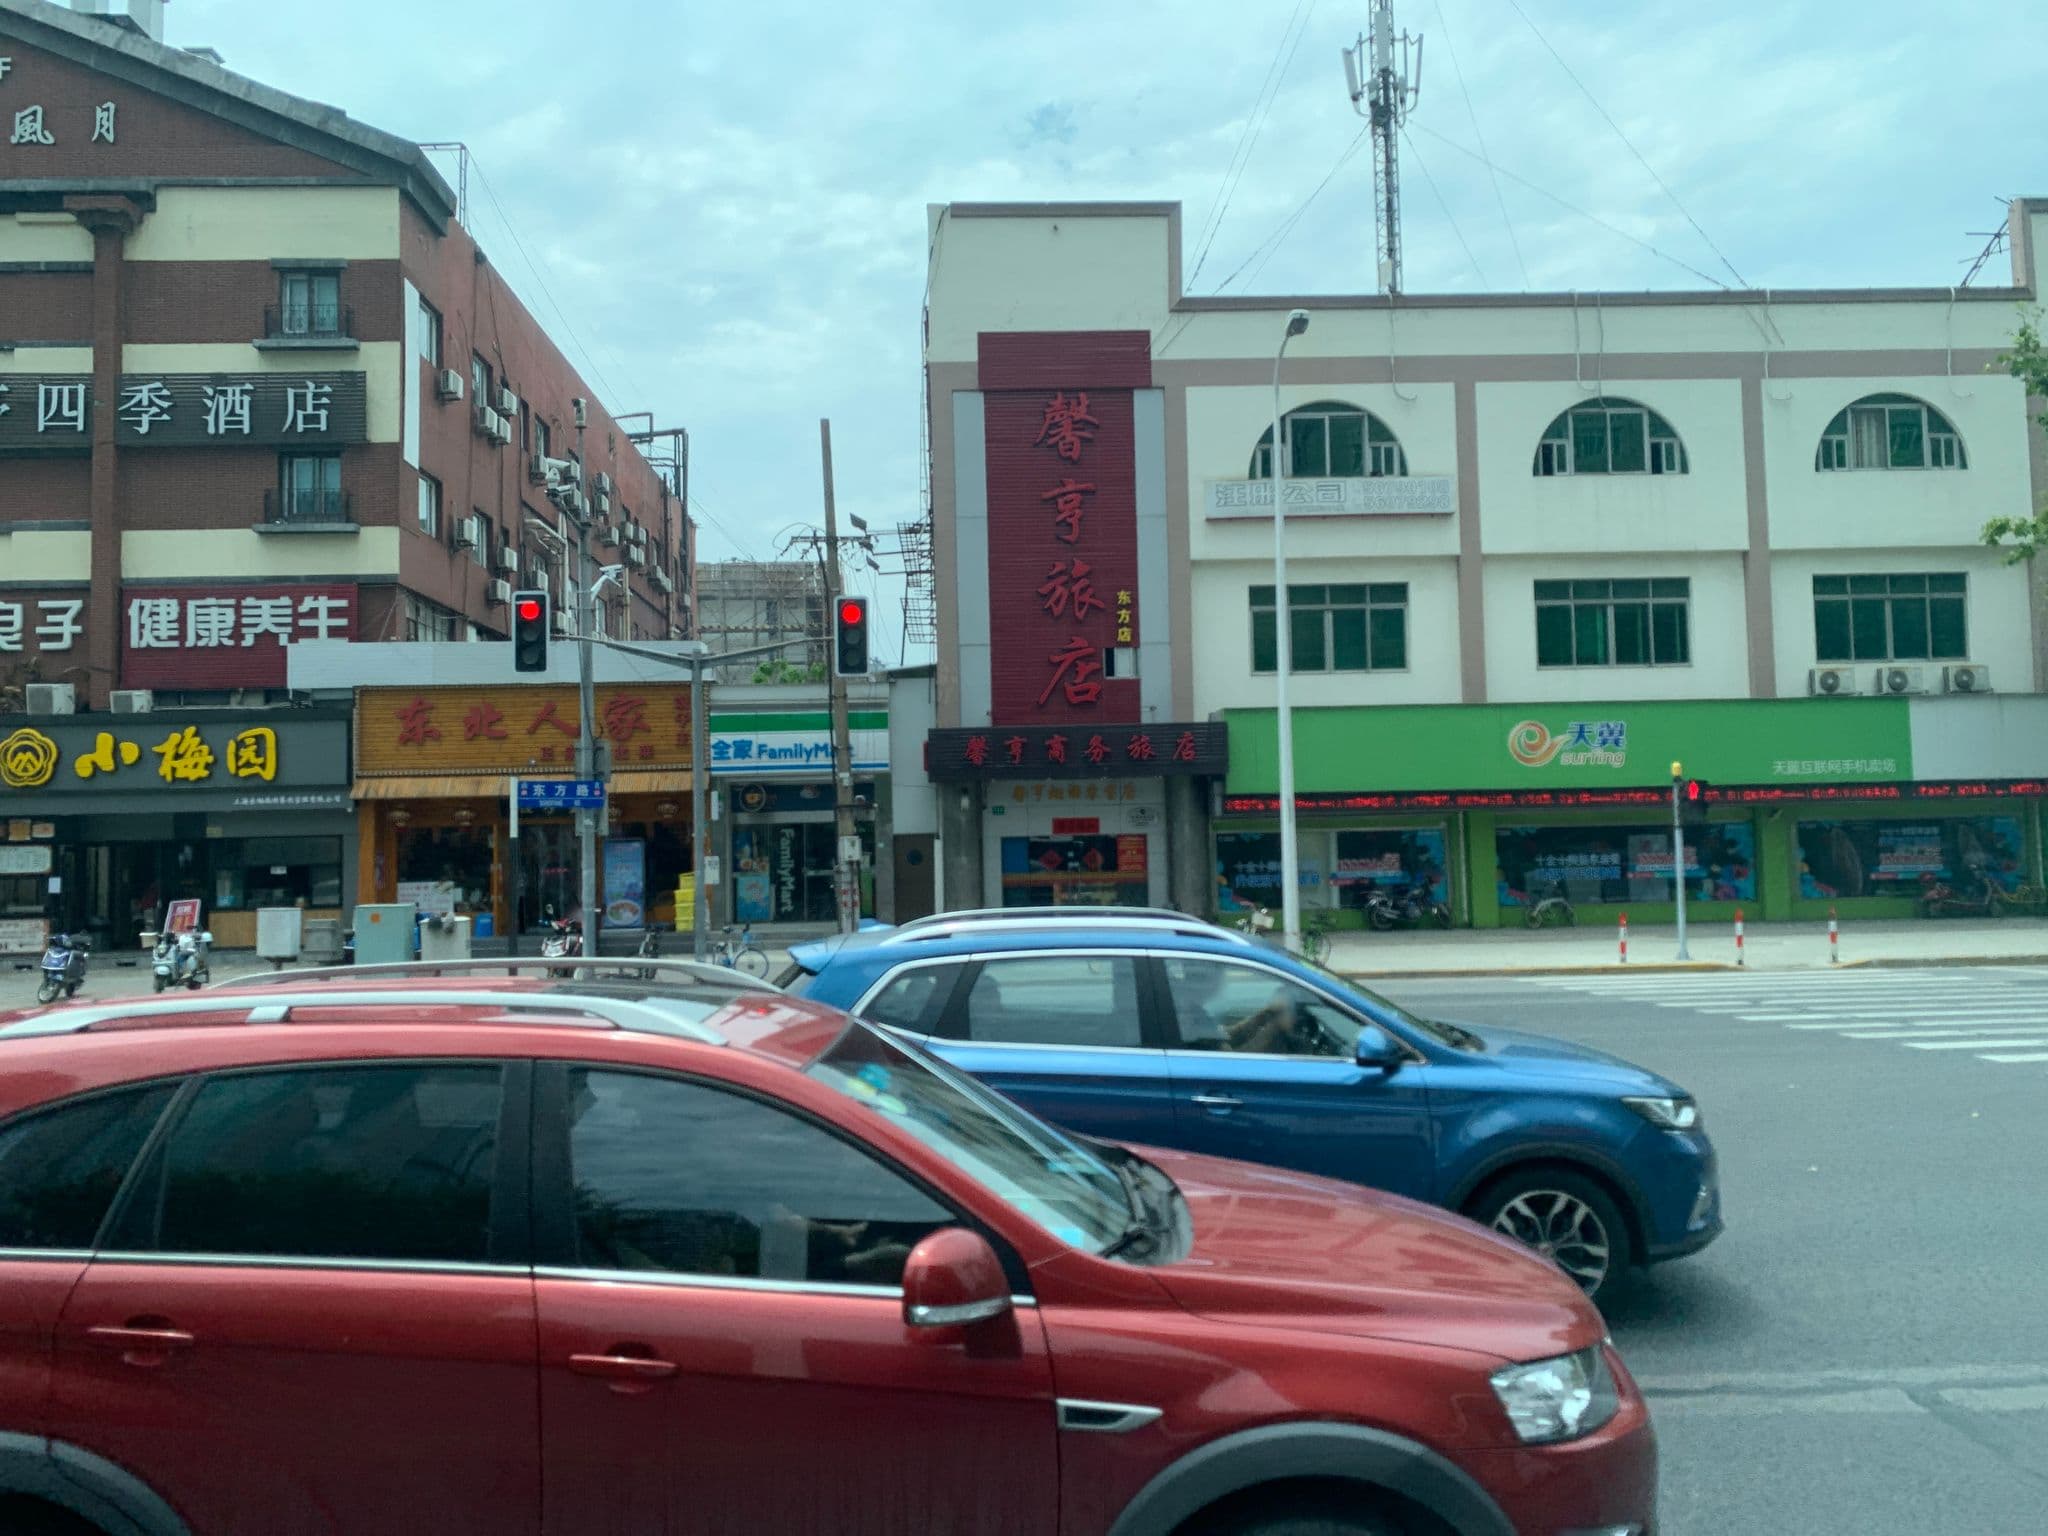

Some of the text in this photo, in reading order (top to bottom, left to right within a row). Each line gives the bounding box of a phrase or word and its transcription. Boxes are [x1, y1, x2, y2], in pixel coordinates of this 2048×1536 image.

[0, 380, 334, 435] 四季酒店
[128, 596, 349, 649] 健康养生
[1116, 589, 1131, 642] 东方店
[393, 693, 652, 745] 东北人家
[1566, 721, 1626, 748] 天翼
[75, 726, 277, 783] 小梅园
[712, 740, 856, 762] 全家 FamilyMt
[964, 732, 1198, 765] 馨亨商务旅店
[533, 784, 589, 797] 东方路
[777, 828, 795, 912] FamilyMart
